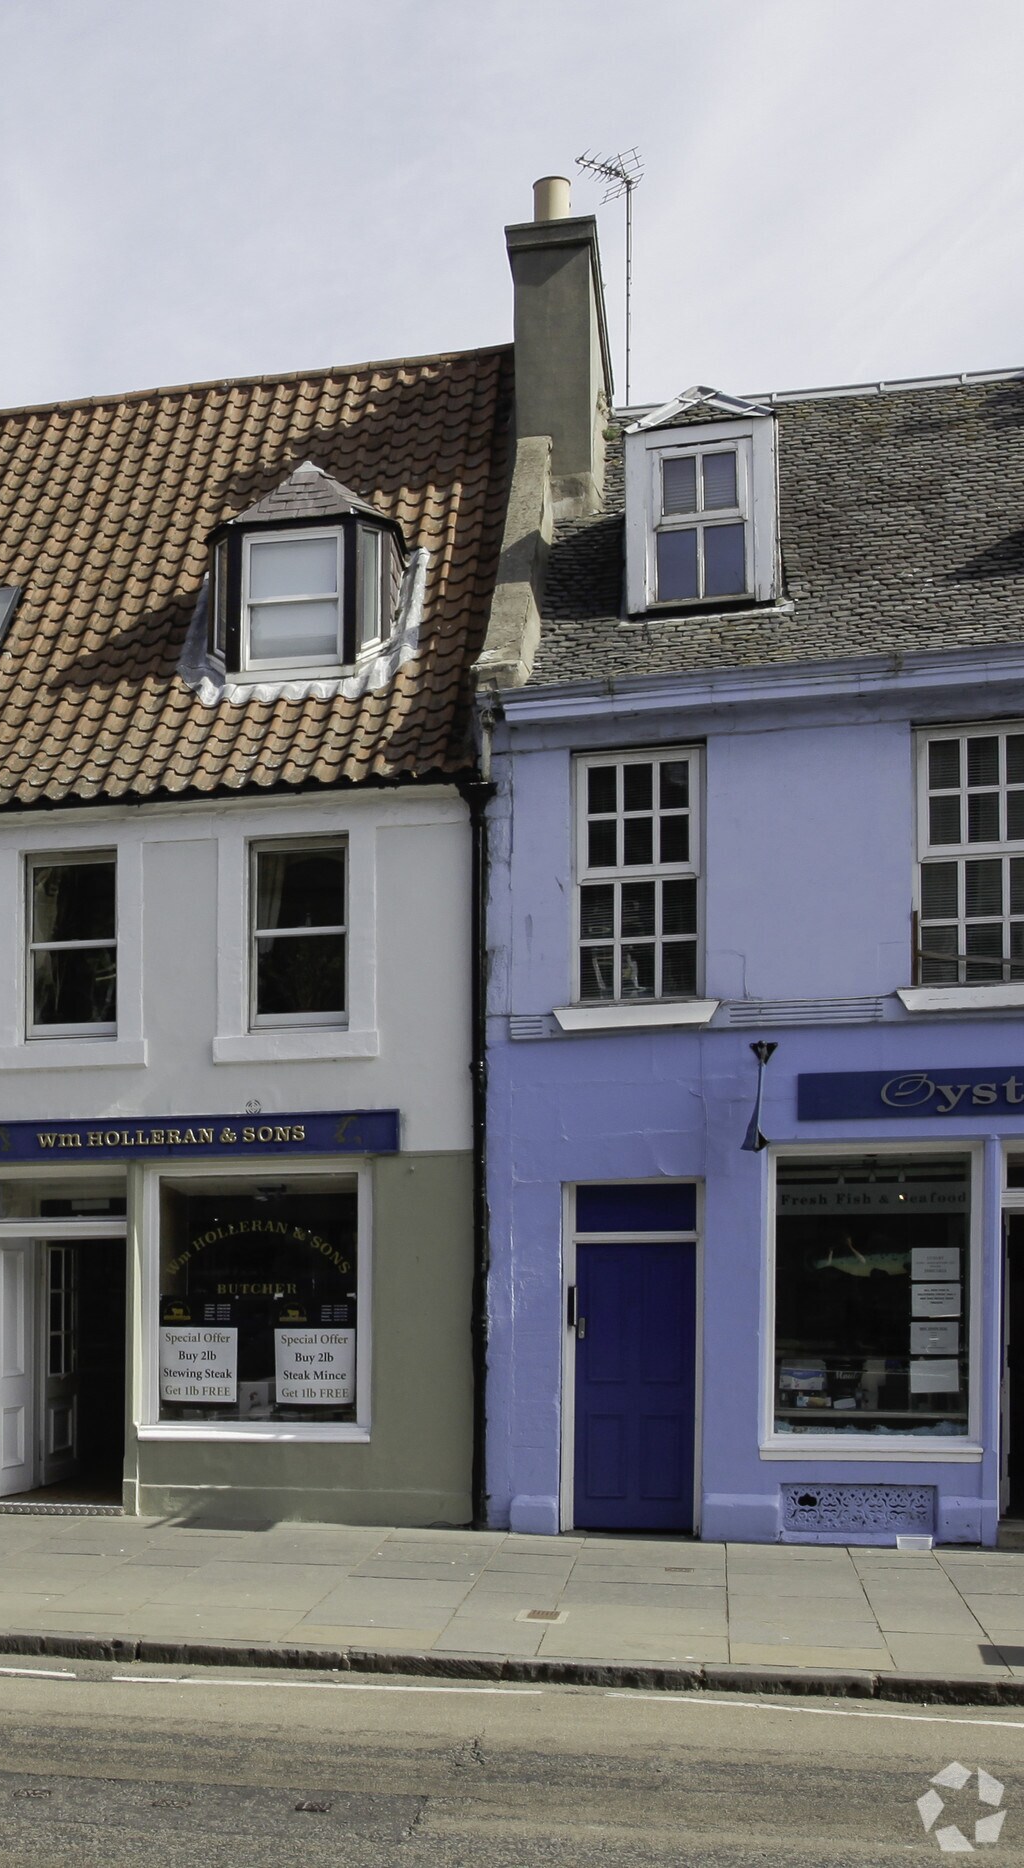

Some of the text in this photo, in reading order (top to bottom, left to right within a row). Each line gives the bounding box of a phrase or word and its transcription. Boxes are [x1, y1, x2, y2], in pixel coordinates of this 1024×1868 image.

[86, 1128, 214, 1147] HOLLERAN
[219, 1127, 237, 1143] &
[242, 1125, 306, 1143] SONS
[781, 1193, 827, 1206] Fresh
[835, 1192, 871, 1205] Fish
[878, 1194, 889, 1204] &
[192, 1220, 288, 1252] HOLLERAN
[292, 1227, 306, 1241] &
[310, 1235, 351, 1275] SONS
[217, 1283, 297, 1295] BUTCHER
[165, 1332, 231, 1345] Special Offer
[280, 1334, 349, 1347] Special Offer
[178, 1350, 217, 1363] Buy 2lb
[295, 1352, 334, 1365] Buy 2lb
[163, 1367, 233, 1381] Stewing Steak
[283, 1369, 347, 1380] Steak Mince
[165, 1385, 231, 1396] Get 1lb FREE
[281, 1388, 350, 1398] Get 1lb FREE
